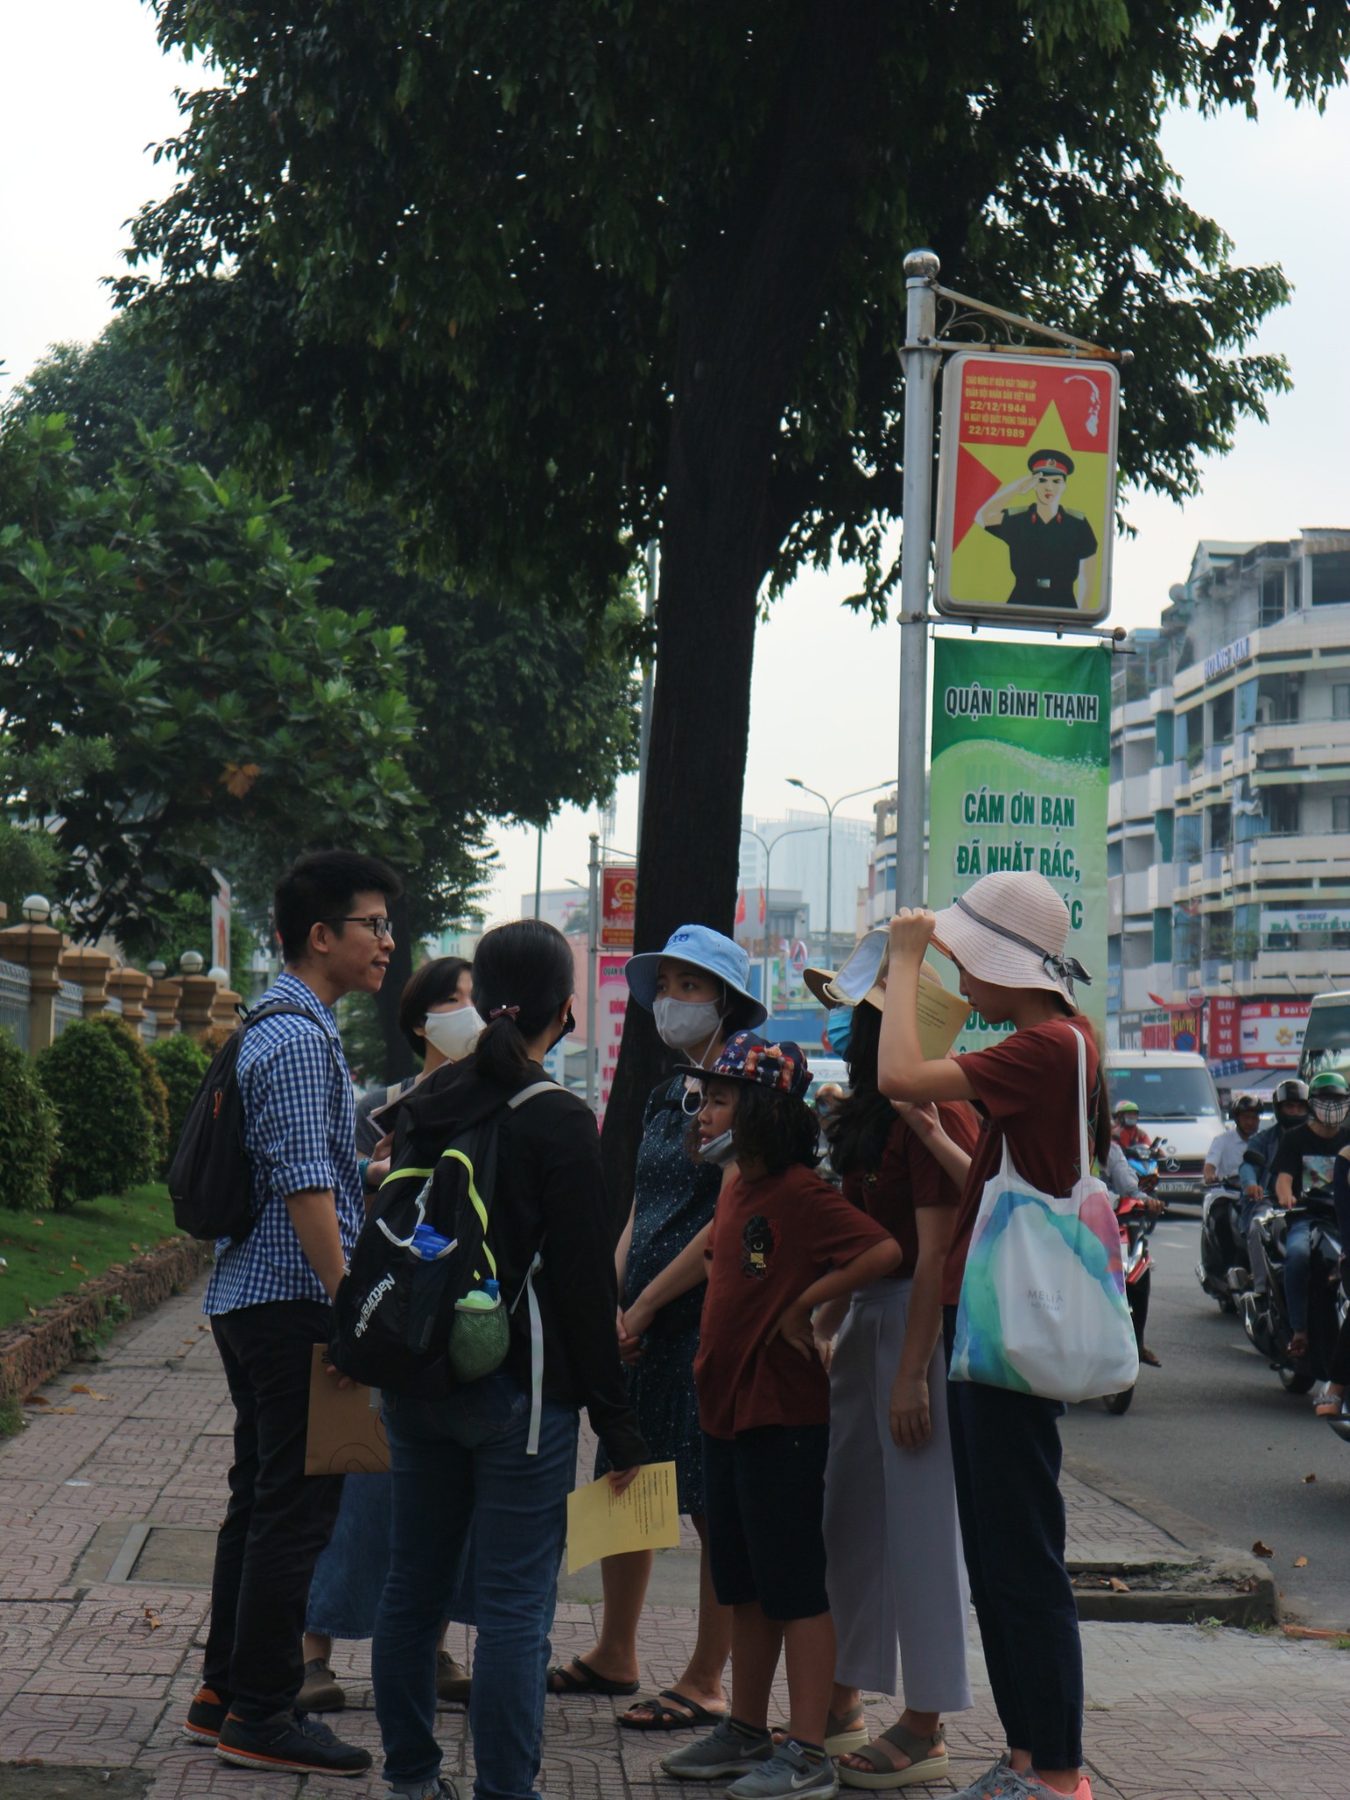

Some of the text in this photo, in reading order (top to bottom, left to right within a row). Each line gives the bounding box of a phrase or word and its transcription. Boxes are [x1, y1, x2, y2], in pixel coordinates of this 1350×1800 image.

[970, 400, 1027, 413] 22/12/1944
[968, 425, 1026, 438] 22/12/1989
[945, 683, 1098, 725] QUẬN BÌNH THẠNH
[964, 786, 1076, 833] CÁM ƠN BẠN
[956, 839, 981, 875] ĐÃ
[1040, 841, 1080, 882] RÁC,
